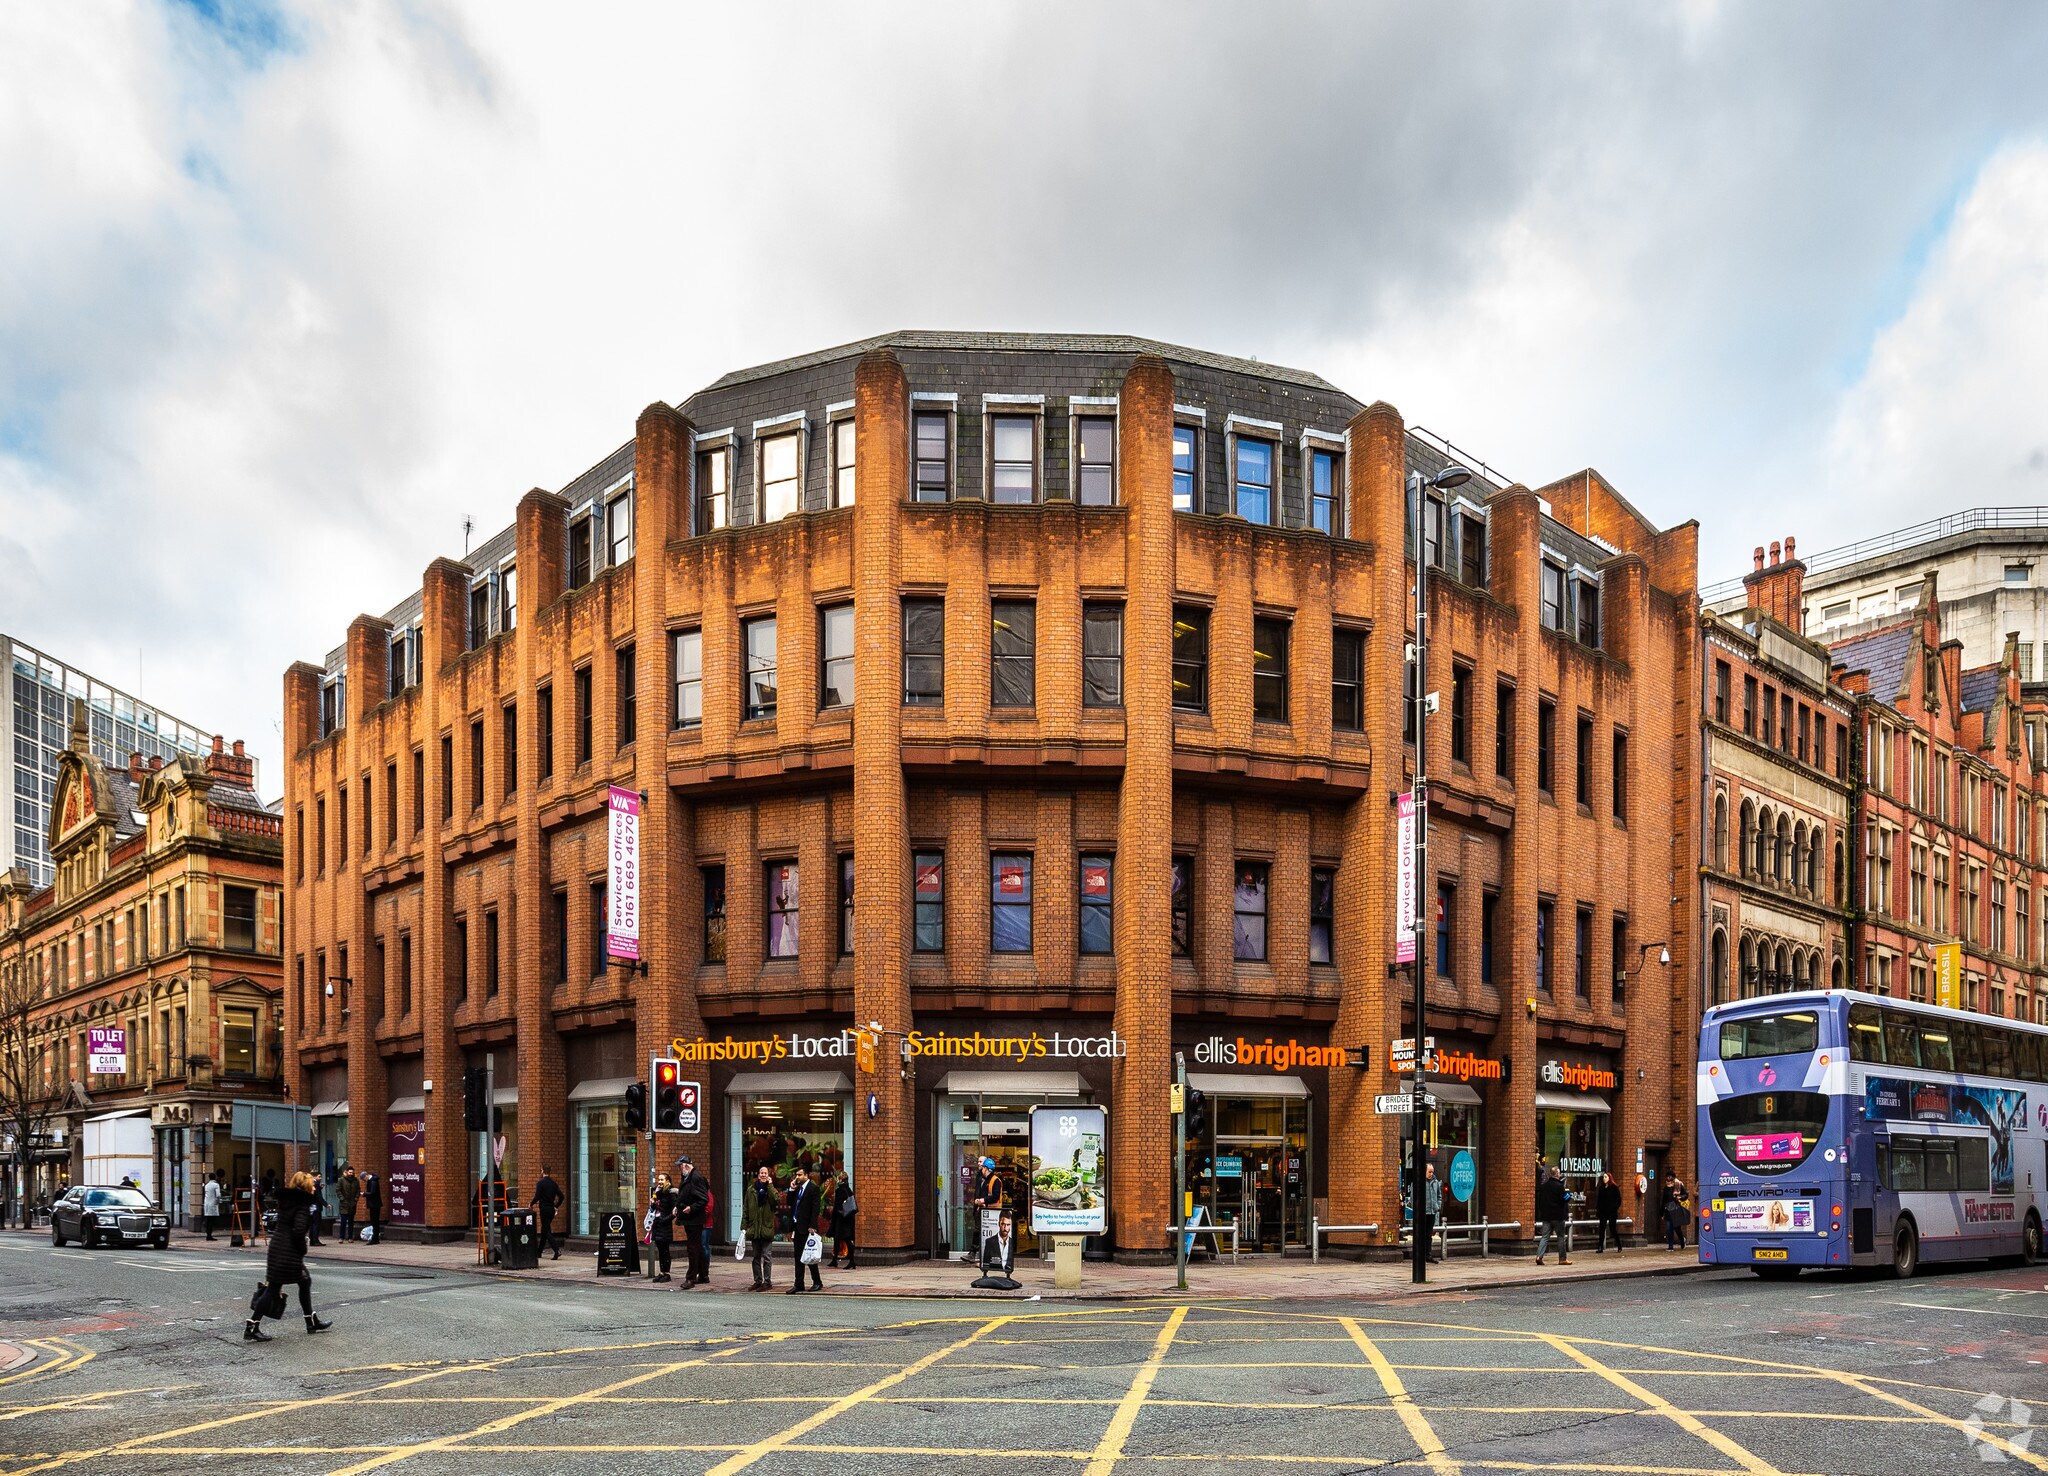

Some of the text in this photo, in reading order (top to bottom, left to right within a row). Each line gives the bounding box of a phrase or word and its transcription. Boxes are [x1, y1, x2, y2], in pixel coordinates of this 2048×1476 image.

[611, 794, 629, 811] VIA
[625, 815, 635, 856] 4670
[1403, 817, 1411, 867] Offices
[614, 812, 623, 927] Serviced Offices
[625, 860, 635, 890] 669
[1402, 871, 1411, 932] Serviced
[625, 894, 635, 929] 0161
[1941, 949, 1950, 993] BRASIL
[90, 1029, 124, 1042] TO LET
[672, 1029, 848, 1065] Sainsbury's Local
[907, 1030, 1119, 1063] Sainsbury's Local
[1194, 1036, 1346, 1072] ellisbrigham
[99, 1055, 118, 1064] c&m
[1392, 1049, 1430, 1061] MOUNTN
[1541, 1060, 1615, 1091] ellisbrigham
[1385, 1095, 1410, 1103] BRIDGE
[1765, 1096, 1774, 1113] 8
[1876, 1097, 1897, 1107] FEBRUARY
[1385, 1104, 1410, 1113] STREET
[392, 1121, 417, 1135] Sainsbury's
[1560, 1157, 1602, 1172] 10 YEARS ON
[1747, 1162, 1792, 1170] www.firstgroup.com
[1452, 1170, 1473, 1183] OFFERS
[1719, 1176, 1739, 1186] 33705
[1729, 1203, 1765, 1213] wellwoman
[1965, 1202, 2015, 1222] MANCHESTER
[1035, 1213, 1043, 1221] Say
[1758, 1250, 1771, 1258] SN12
